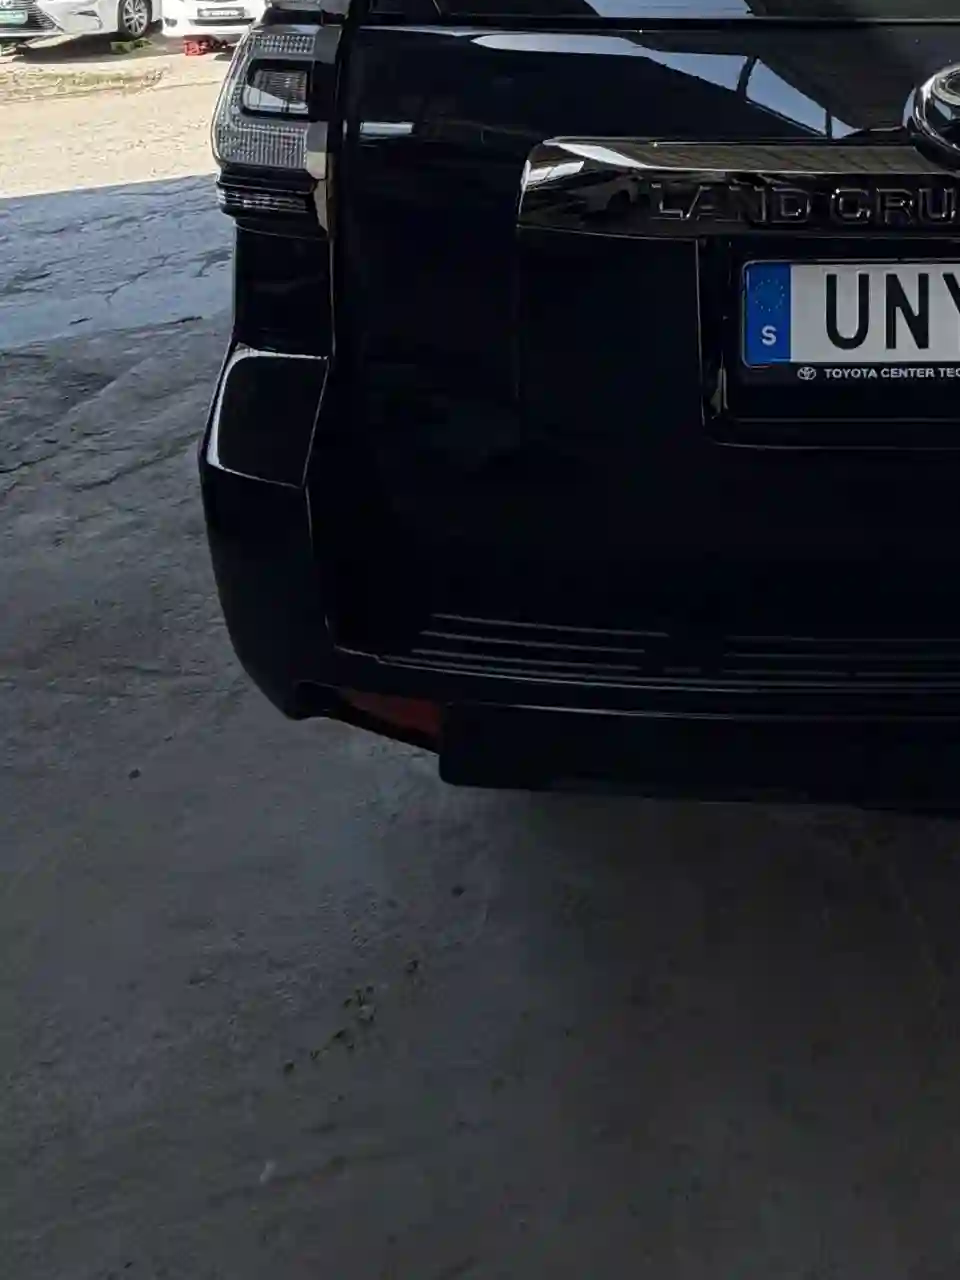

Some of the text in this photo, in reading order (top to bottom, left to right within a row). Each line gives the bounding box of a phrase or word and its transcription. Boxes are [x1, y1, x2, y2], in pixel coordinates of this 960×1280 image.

[651, 183, 812, 222] LAND
[760, 325, 777, 346] S
[823, 368, 879, 380] TOYOTA
[880, 367, 936, 379] CENTER
